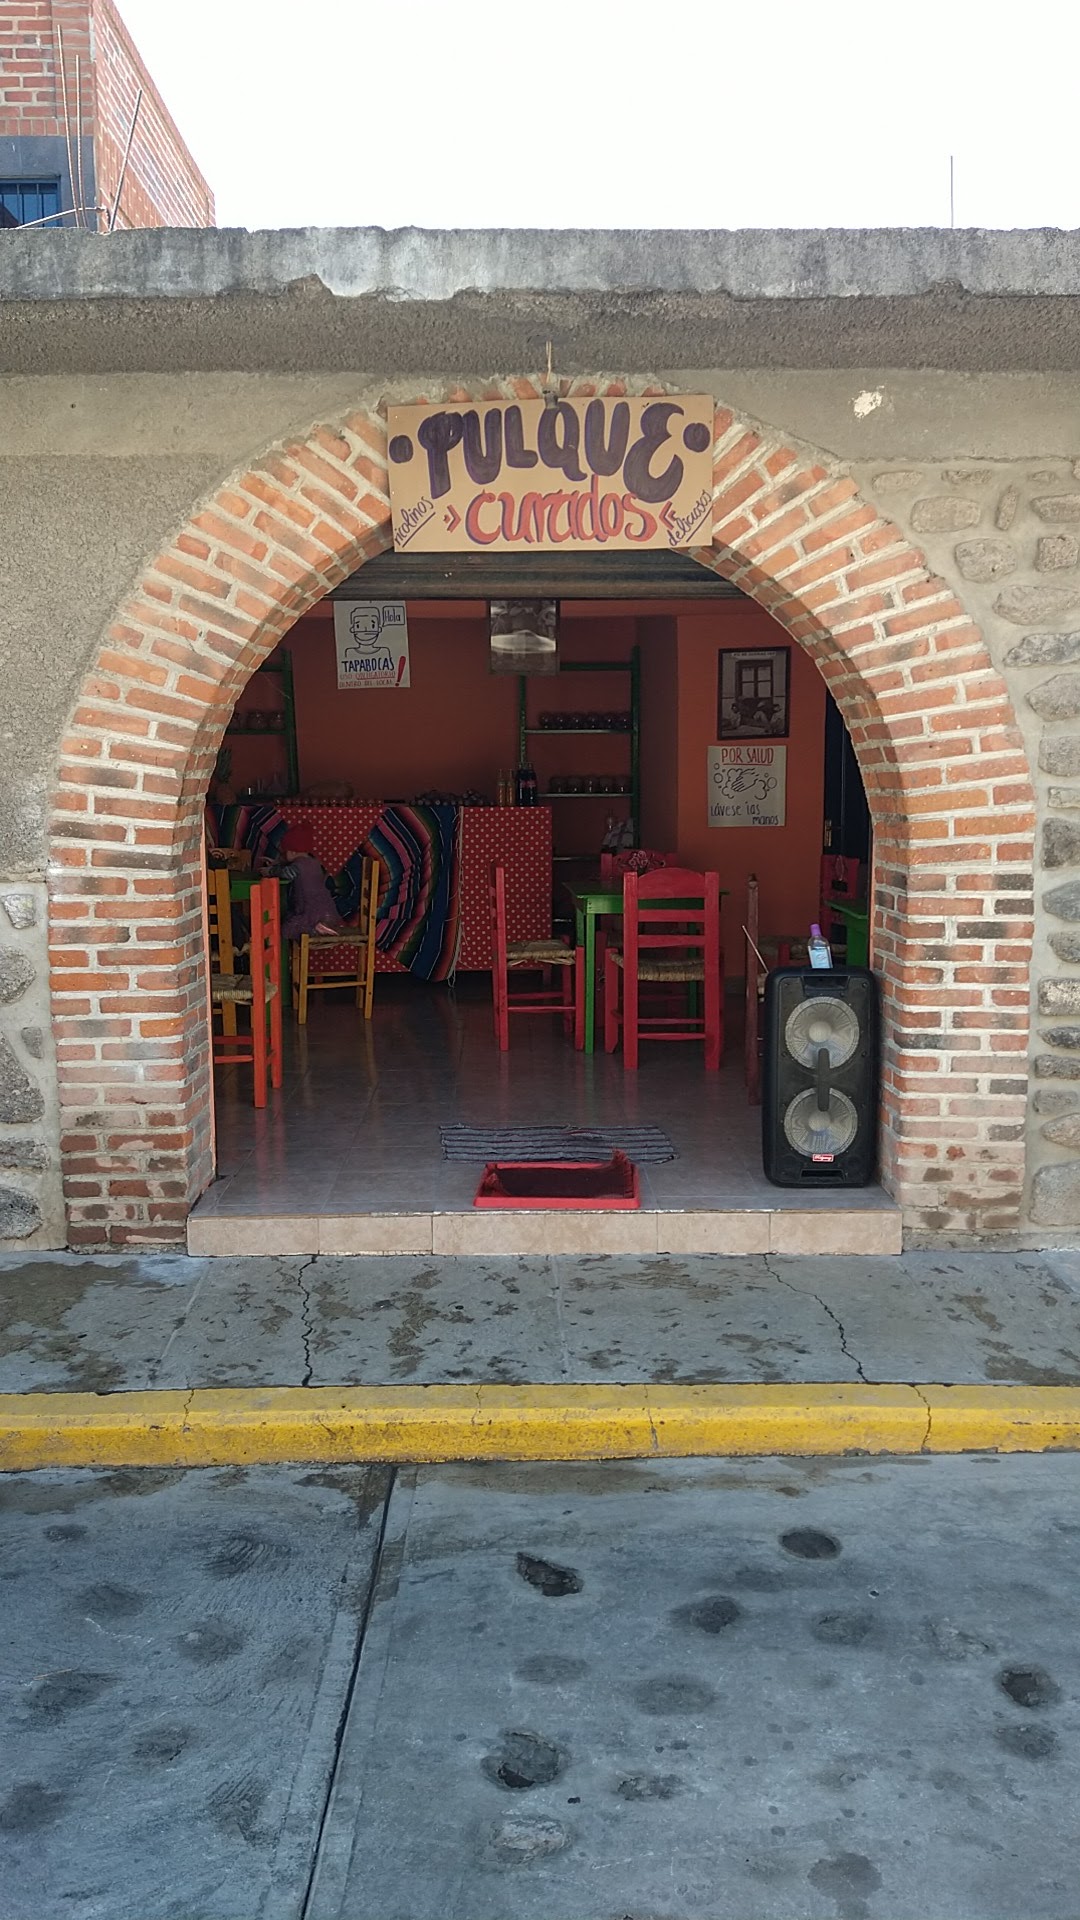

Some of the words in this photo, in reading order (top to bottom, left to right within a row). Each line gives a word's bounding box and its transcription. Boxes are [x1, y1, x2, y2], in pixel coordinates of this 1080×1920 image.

[418, 399, 684, 503] PULQUE
[385, 608, 401, 622] Hola
[341, 657, 395, 673] TAPABOCAS
[721, 748, 743, 763] POR
[747, 748, 774, 764] SALUD
[752, 815, 779, 826] manos
